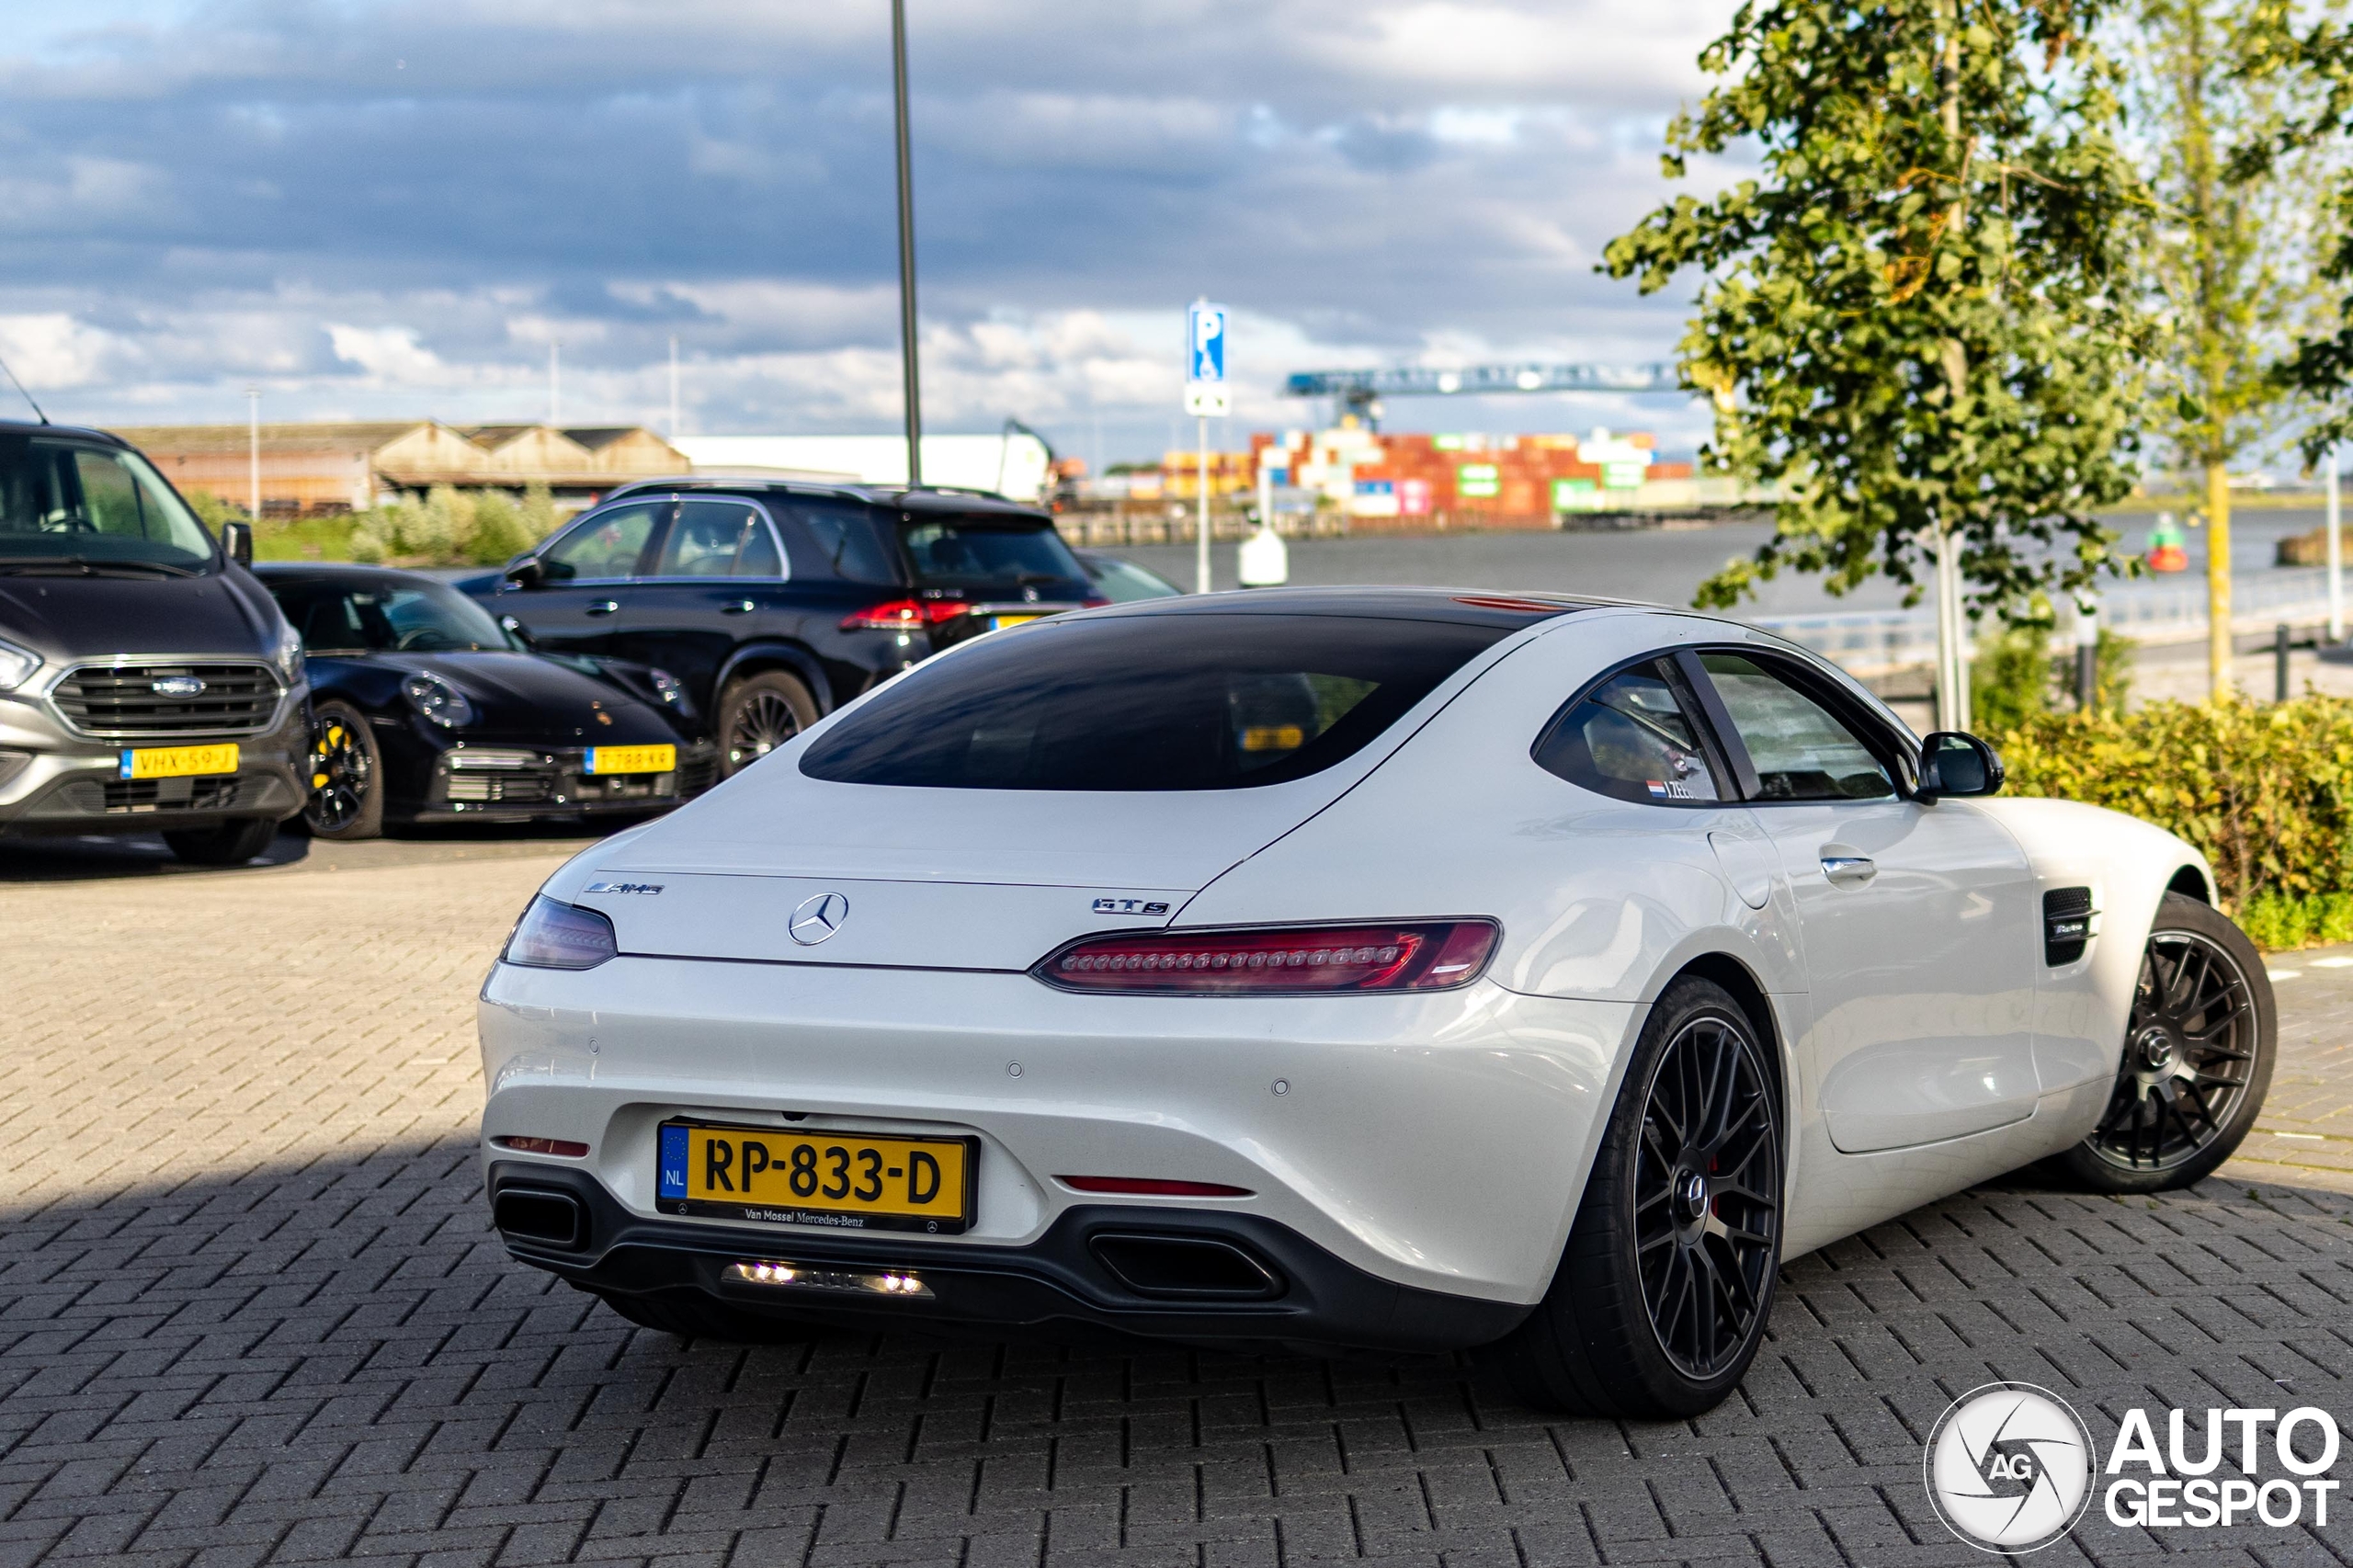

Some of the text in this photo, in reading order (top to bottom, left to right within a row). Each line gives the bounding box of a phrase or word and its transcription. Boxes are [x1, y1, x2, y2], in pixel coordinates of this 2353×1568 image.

[1197, 312, 1222, 352] P
[665, 1169, 685, 1187] NL
[706, 1138, 941, 1204] RP-833-D
[745, 1209, 865, 1228] Van Mossel Mercedes-Benz
